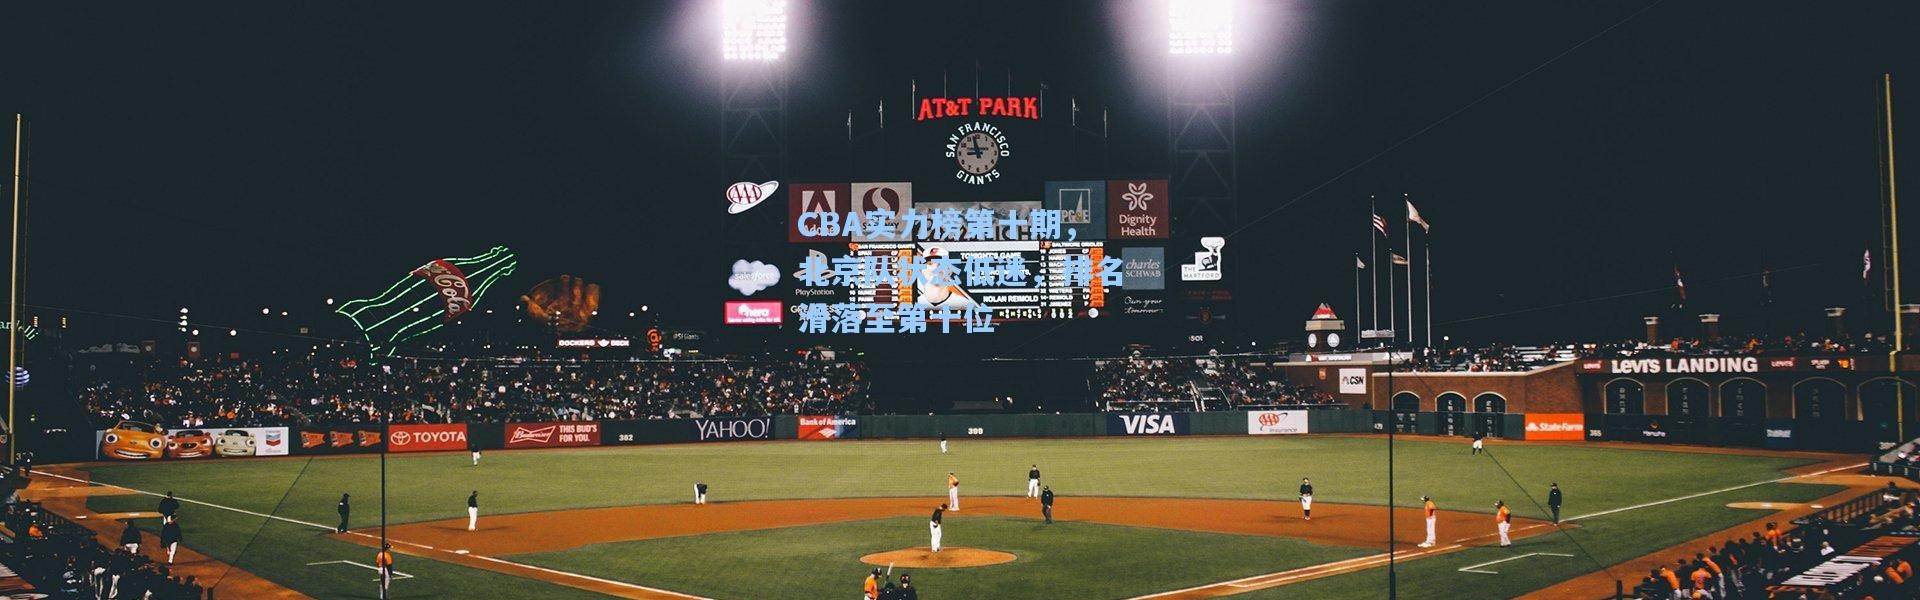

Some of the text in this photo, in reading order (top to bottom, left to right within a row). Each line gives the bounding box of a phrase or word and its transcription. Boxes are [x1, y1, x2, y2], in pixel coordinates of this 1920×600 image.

[917, 96, 1039, 121] AT&T PARK
[945, 121, 1010, 158] SAN FRANCISCO
[956, 169, 1001, 185] GIANTS
[1119, 214, 1157, 227] Dignity
[1121, 226, 1156, 237] Health
[1126, 259, 1161, 270] charles
[1125, 270, 1161, 278] SCHWAB
[795, 288, 835, 298] PlayStation
[1665, 357, 1758, 373] LANDING
[1349, 377, 1364, 385] CSN
[800, 417, 857, 426] Bank of America
[1119, 415, 1176, 435] VISA
[559, 424, 598, 433] THIS BUD'S
[696, 418, 770, 441] YAHOO!
[413, 431, 467, 443] TOYOTA
[515, 430, 551, 440] Budweiser
[559, 433, 590, 443] FOR YOU.
